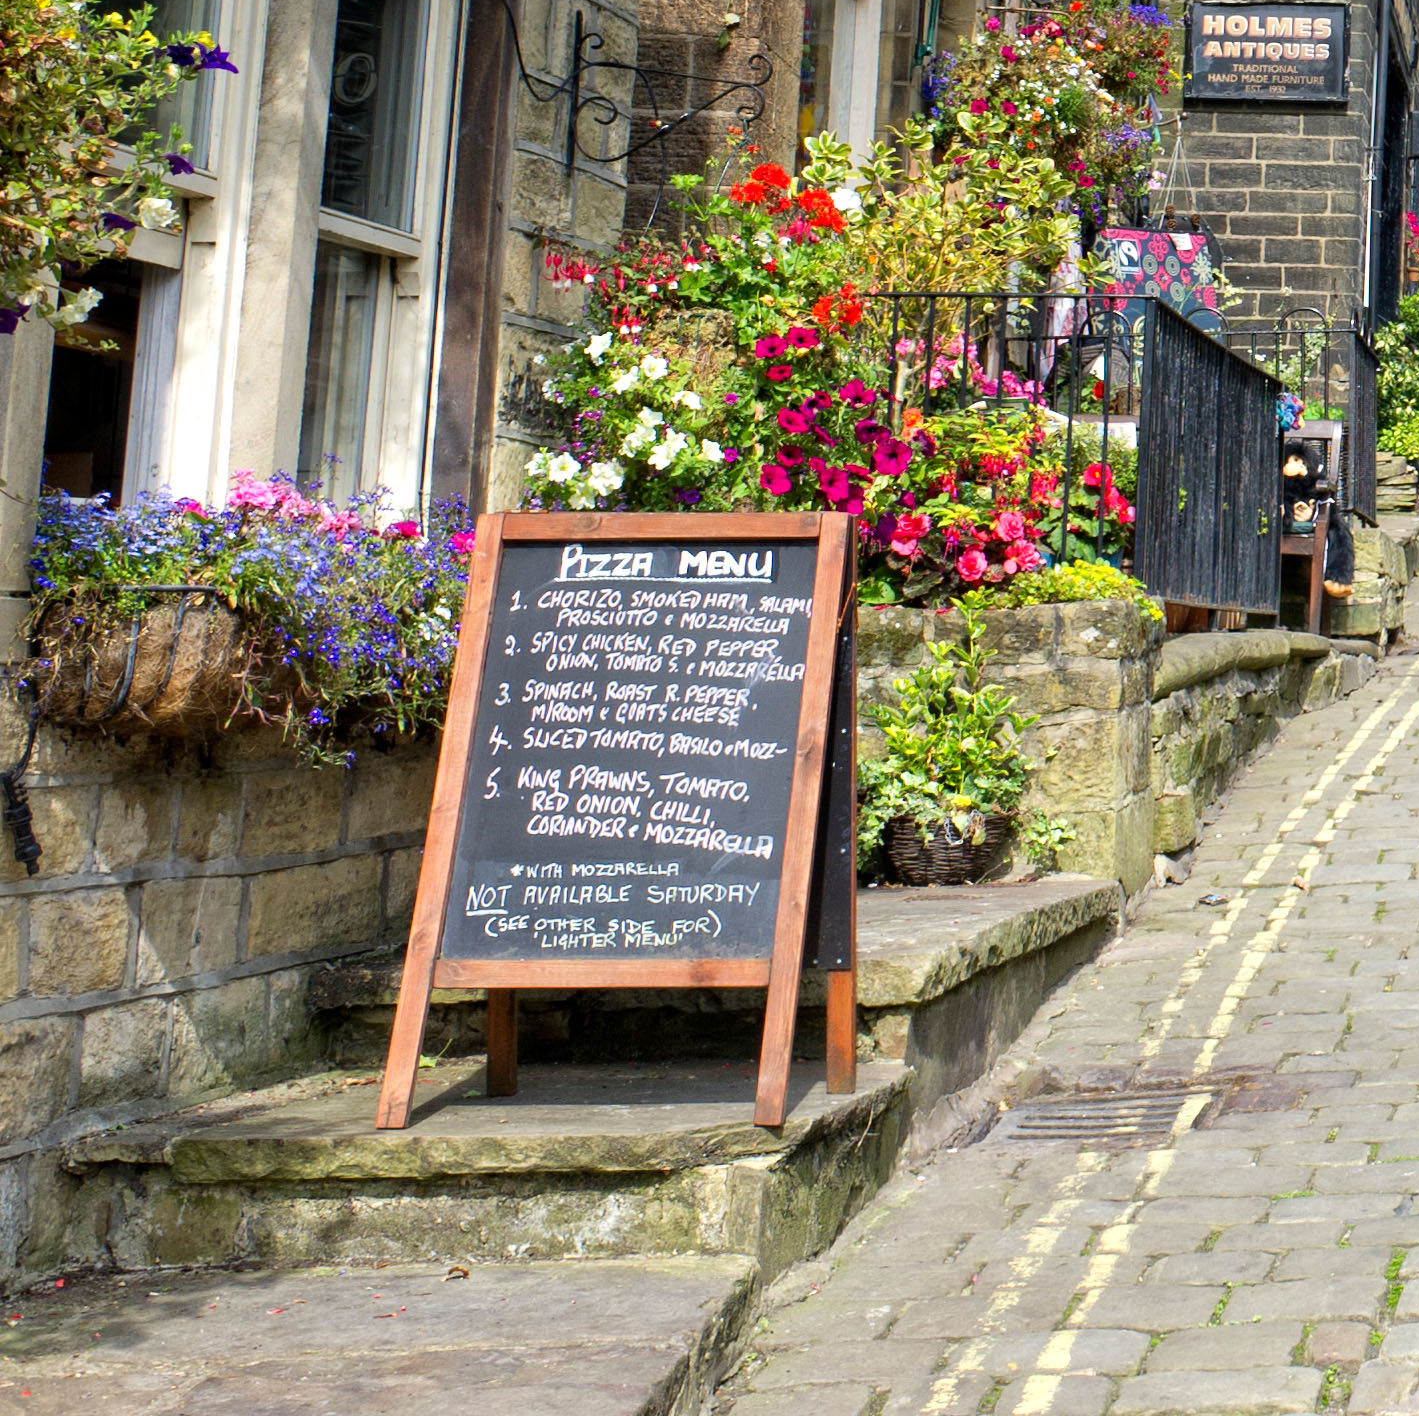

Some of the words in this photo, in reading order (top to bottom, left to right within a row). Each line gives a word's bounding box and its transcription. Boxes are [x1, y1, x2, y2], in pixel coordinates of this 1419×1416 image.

[1202, 14, 1332, 39] HOLMES
[1202, 41, 1330, 61] ANTIQUES
[1207, 73, 1238, 82] HAND
[1241, 74, 1268, 83] MADE
[1272, 75, 1325, 84] FURNITURE
[1233, 64, 1298, 74] TRADITIONAL
[679, 550, 773, 578] MENU
[510, 590, 528, 612] 1.
[537, 588, 623, 611] CHORIZO,
[630, 590, 702, 609] SMOKED
[556, 607, 658, 628] PROSCIUTTO
[680, 612, 790, 635] MOZZARELLA
[504, 635, 521, 657] 2.
[530, 631, 578, 654] SPICY
[582, 631, 653, 655] CHICKEN,
[658, 634, 697, 656] RED
[546, 651, 599, 672] ONION,
[605, 652, 663, 672] TOMATO
[494, 682, 511, 706] 3.
[521, 678, 598, 702] SPINACH,
[604, 680, 658, 702] ROAST
[531, 700, 595, 723] M/ROOM
[615, 702, 667, 724] GOATS
[671, 704, 741, 727] CHEESE
[488, 724, 512, 756] 4.
[523, 726, 588, 749] SLICED
[590, 727, 666, 758] TOMATO,
[483, 766, 502, 800] 5.
[517, 765, 562, 792] KING
[568, 764, 655, 798] PRAWNS,
[531, 790, 569, 812] RED
[650, 800, 715, 828] CHILLI,
[526, 814, 627, 839] CORIANDER
[643, 822, 774, 860] MOZZARELLA
[571, 862, 680, 877] MOZZARELLA
[465, 883, 512, 911] NOT
[523, 884, 632, 906] AVAILABLE
[647, 882, 760, 906] SATURDAY
[484, 915, 530, 938] (SEE
[534, 917, 596, 933] OTHER
[608, 918, 655, 935] SIDE
[672, 909, 722, 938] FOR)
